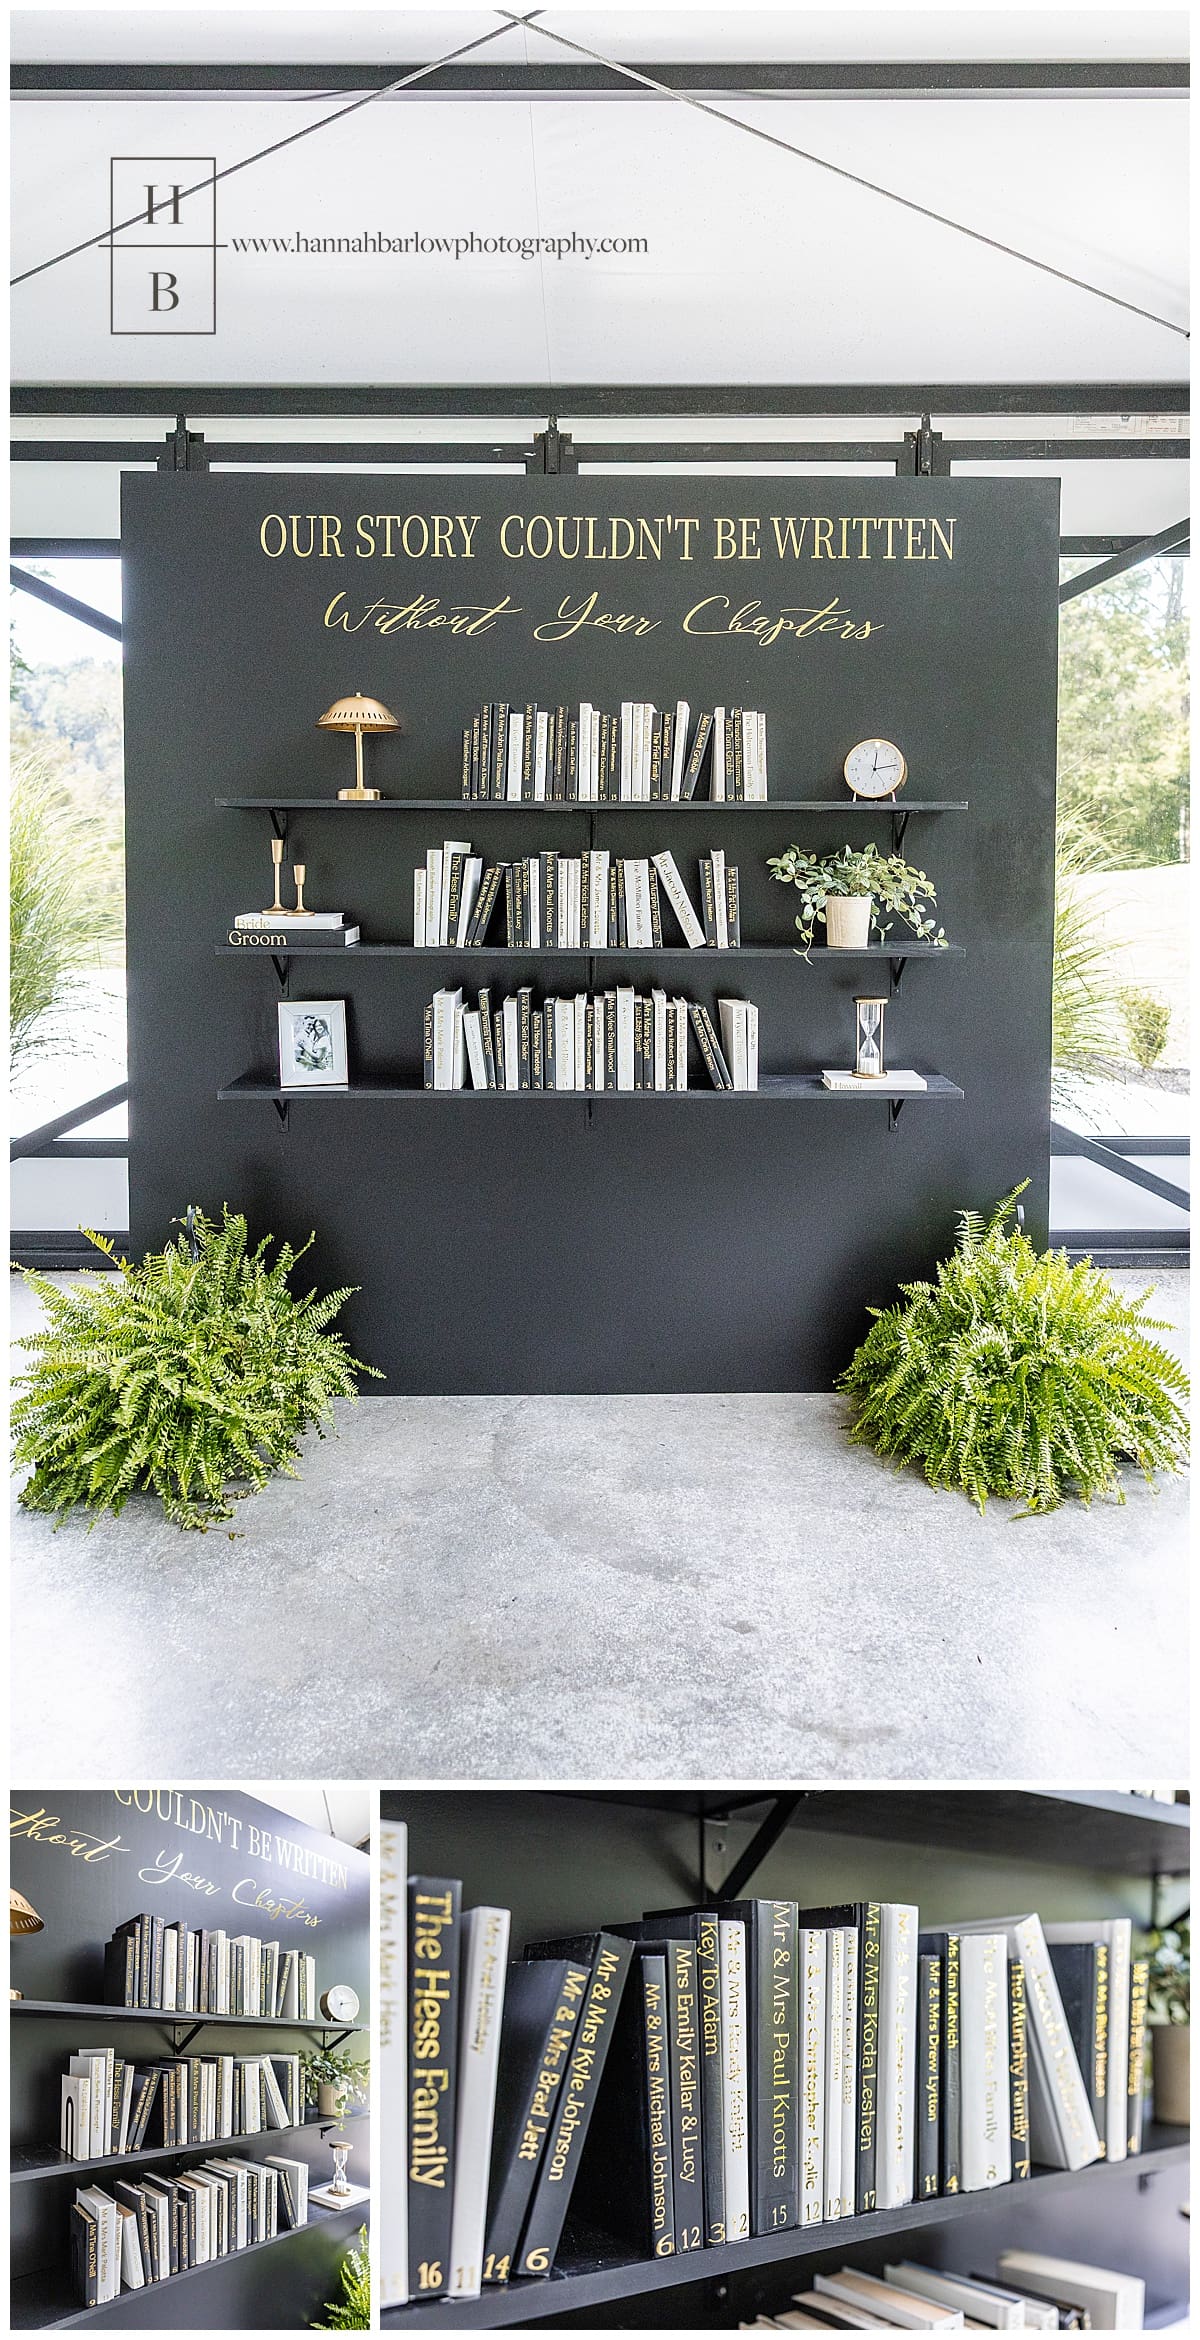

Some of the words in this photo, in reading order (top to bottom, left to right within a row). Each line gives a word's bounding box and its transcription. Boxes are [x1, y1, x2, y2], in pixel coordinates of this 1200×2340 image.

[260, 514, 346, 558] OUR
[355, 514, 482, 559] STORY
[499, 514, 700, 561] COULDN'T
[713, 517, 762, 560] BE
[770, 517, 957, 562] WRITTEN
[323, 591, 523, 635] Without
[533, 591, 662, 642] Your
[683, 595, 884, 646] Chapters
[526, 704, 533, 714] Mr
[734, 708, 741, 719] Mr
[725, 719, 733, 731] Mr
[651, 761, 659, 782] Family
[726, 751, 734, 775] Grubb
[452, 856, 461, 871] The
[546, 853, 554, 864] Mr
[582, 852, 589, 862] Mr
[451, 872, 460, 892] Hess
[546, 873, 554, 888] Mrs
[449, 894, 460, 922] Family
[546, 890, 554, 906] Paul
[663, 870, 682, 900] Jacob
[676, 900, 696, 937] Nelson
[228, 930, 288, 946] Groom
[236, 918, 271, 930] Bride
[521, 994, 528, 1005] Mr
[607, 998, 615, 1010] Ms
[606, 1011, 616, 1031] Kylee
[607, 1032, 616, 1073] Smallwood
[248, 1824, 273, 1862] BE
[274, 1835, 348, 1890] WRITTEN
[138, 1849, 222, 1896] Your
[231, 1878, 323, 1928] Chapters
[414, 1891, 454, 1960] The
[772, 1903, 790, 1942] Mr
[864, 1903, 881, 1936] Mr
[696, 1920, 716, 1962] Key
[727, 1927, 742, 1956] Mr
[864, 1940, 880, 1959] &
[947, 1935, 960, 1958] Ms
[596, 1949, 621, 1982] Mr
[675, 1947, 693, 1989] Mrs
[726, 1958, 742, 1977] &
[772, 1947, 791, 1969] &
[928, 1961, 940, 1984] Mr
[561, 1970, 587, 2002] Mr
[701, 1963, 720, 1990] To
[863, 1962, 879, 2008] Mrs
[947, 1961, 959, 1989] Kim
[1008, 1962, 1026, 1999] The
[590, 1982, 613, 2001] &
[644, 1983, 662, 2010] Mr
[727, 1979, 742, 2019] Mrs
[772, 1974, 790, 2025] Mrs
[928, 1986, 940, 2000] &
[412, 1968, 452, 2060] Hess
[554, 2005, 577, 2022] &
[581, 2003, 608, 2045] Mrs
[647, 2014, 662, 2031] &
[674, 1993, 696, 2051] Emily
[702, 1994, 720, 2057] Adam
[928, 2003, 939, 2032] Mrs
[946, 1991, 959, 2049] Matvich
[544, 2027, 572, 2066] Mrs
[647, 2034, 665, 2073] Mrs
[861, 2012, 878, 2070] Koda
[928, 2034, 940, 2072] Drew
[1008, 2001, 1027, 2077] Murphy
[114, 2063, 122, 2078] The
[569, 2046, 595, 2092] Kyle
[772, 2032, 790, 2086] Paul
[113, 2080, 122, 2100] Hess
[529, 2070, 561, 2117] Brad
[678, 2054, 699, 2112] Kellar
[803, 2027, 821, 2132] Christopher
[649, 2077, 667, 2148] Michael
[859, 2074, 877, 2152] Leshen
[925, 2075, 940, 2122] Lytton
[983, 2080, 998, 2143] Family
[1010, 2080, 1029, 2143] Family
[112, 2101, 121, 2129] Family
[407, 2067, 450, 2189] Family
[680, 2115, 697, 2133] &
[518, 2119, 547, 2161] Jett
[547, 2093, 586, 2182] Johnson
[772, 2093, 790, 2178] Knotts
[678, 2136, 698, 2184] Lucy
[1014, 2160, 1029, 2178] 7
[651, 2151, 669, 2231] Johnson
[925, 2175, 938, 2194] 11
[946, 2175, 958, 2193] 4
[772, 2204, 788, 2226] 15
[805, 2201, 821, 2222] 12
[827, 2197, 841, 2217] 12
[655, 2232, 674, 2257] 6
[680, 2228, 702, 2250] 12
[707, 2222, 726, 2244] 3
[482, 2252, 512, 2280] 14
[525, 2247, 550, 2272] 6
[415, 2260, 445, 2290] 16
